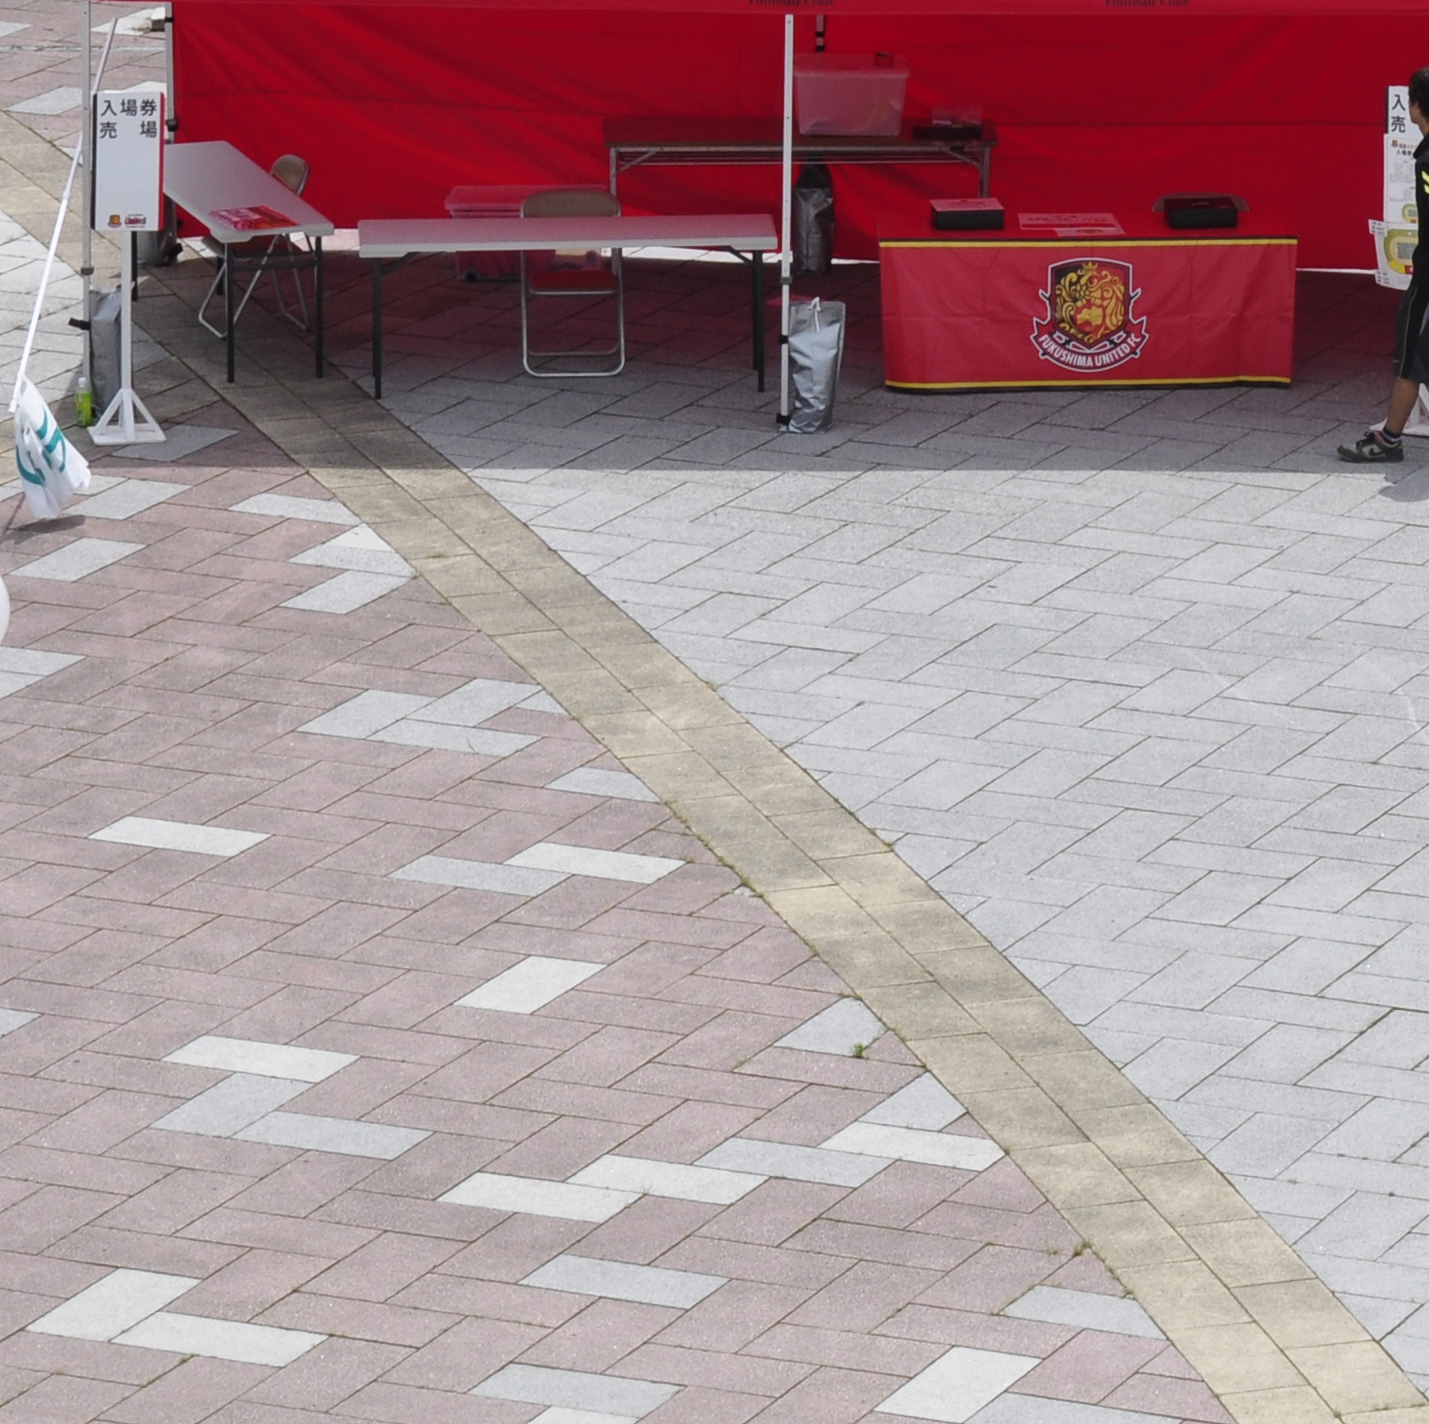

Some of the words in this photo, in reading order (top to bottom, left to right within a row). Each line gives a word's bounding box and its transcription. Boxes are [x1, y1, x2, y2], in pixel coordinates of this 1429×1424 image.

[100, 98, 157, 117] 入場券
[1038, 333, 1094, 367] FUKUSHIMA
[1094, 344, 1131, 366] UNITED
[1127, 332, 1142, 349] FC
